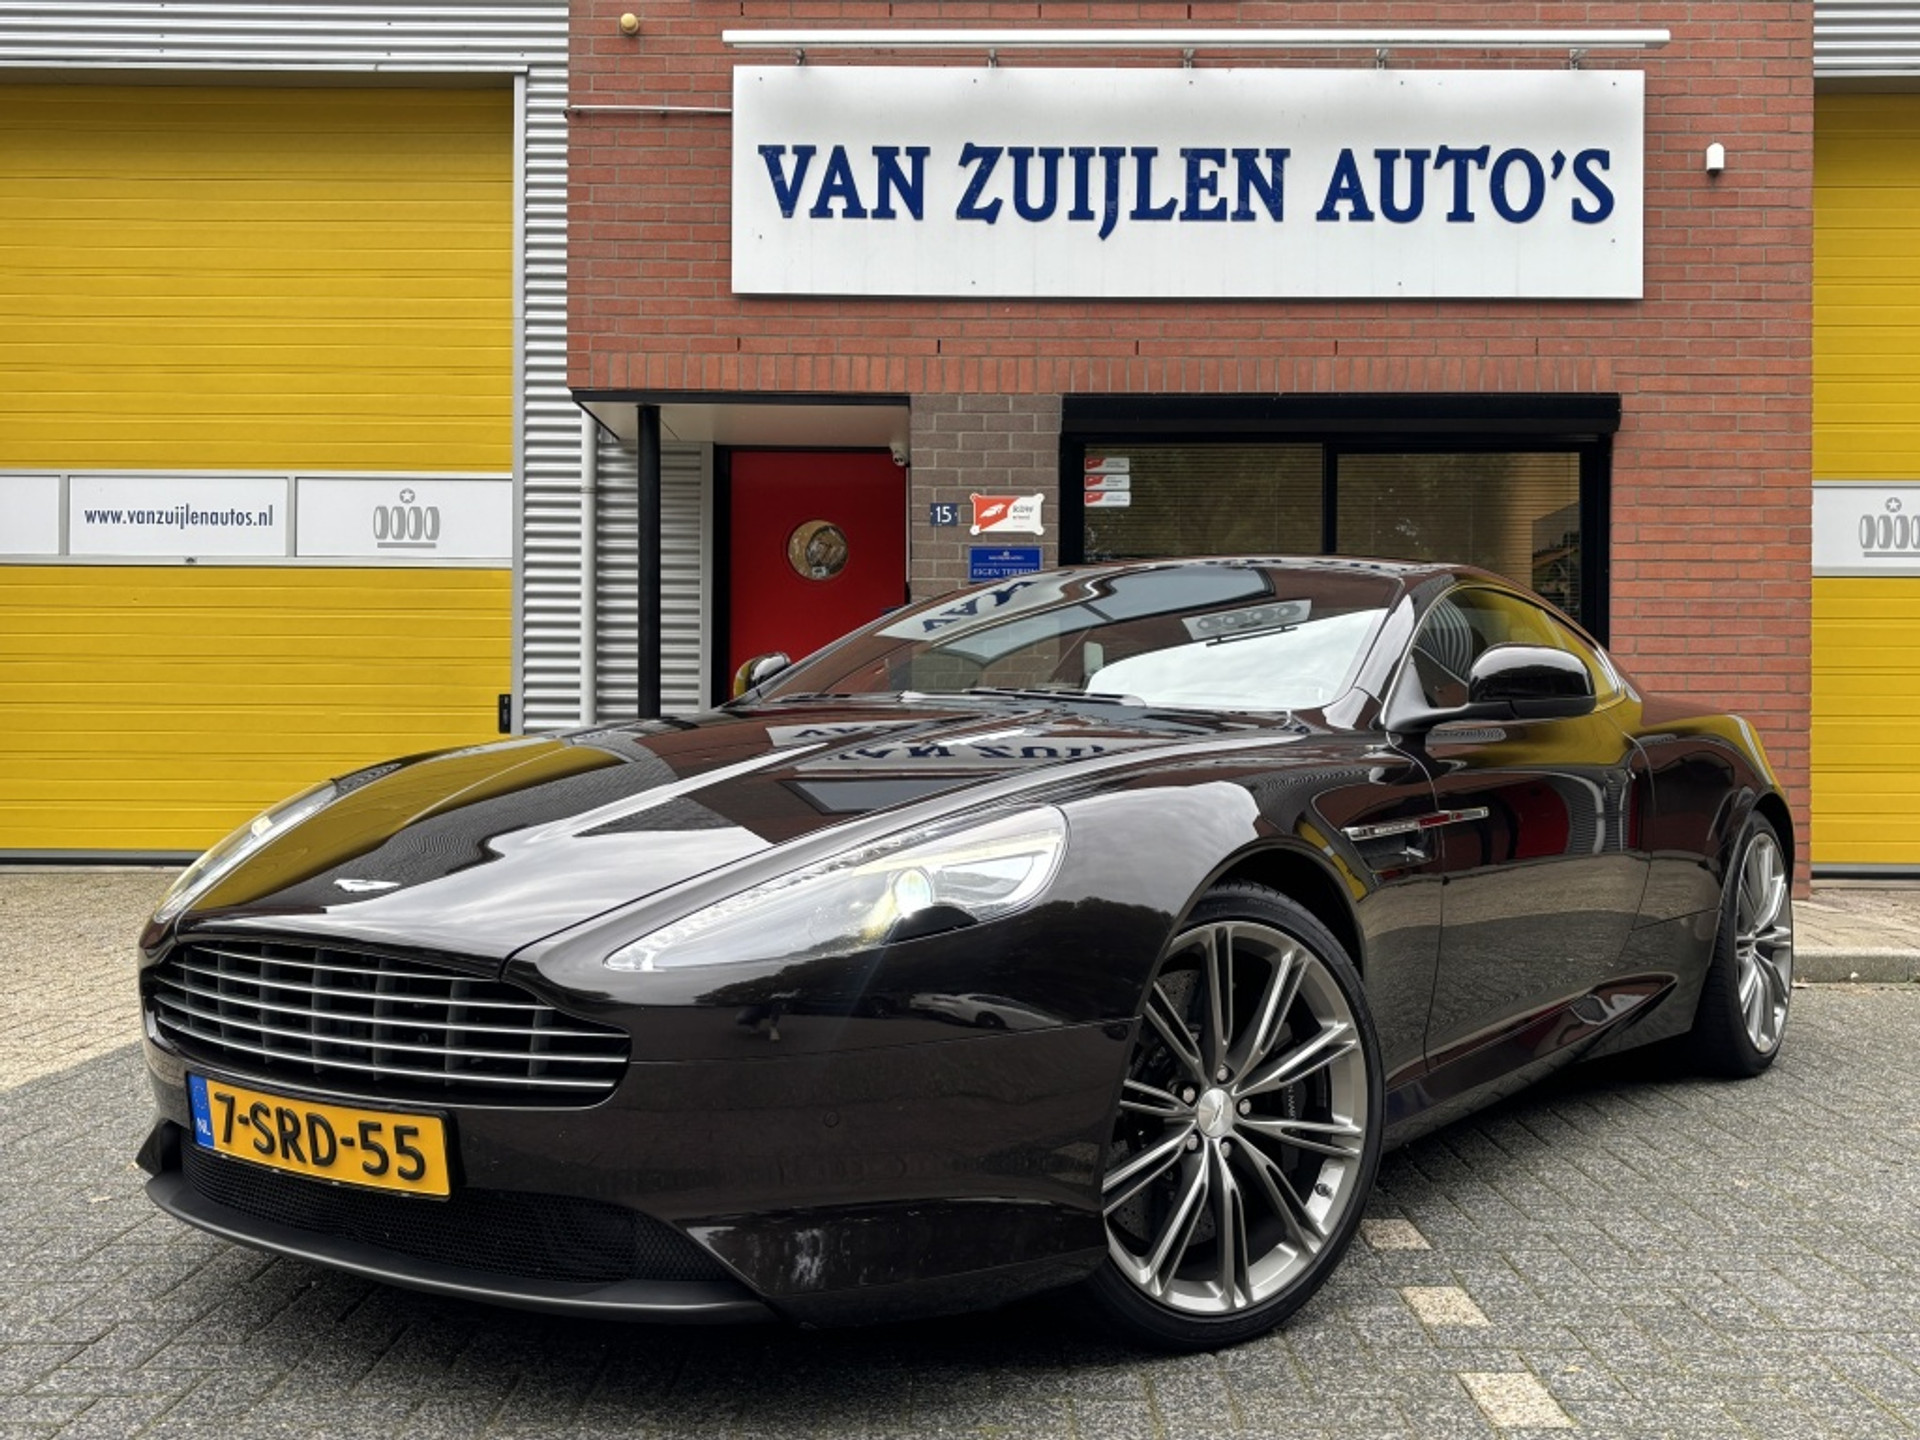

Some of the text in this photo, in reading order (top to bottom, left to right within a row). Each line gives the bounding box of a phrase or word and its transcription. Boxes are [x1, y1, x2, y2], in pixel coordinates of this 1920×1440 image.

[758, 143, 1615, 239] VAN ZUIJLEN AUTO'S
[84, 503, 274, 530] www.vanzuijlenautos.nl
[935, 505, 952, 523] 15
[973, 567, 1000, 577] EIGEN
[196, 1117, 212, 1136] NL
[214, 1092, 426, 1181] 7-SRD-55
